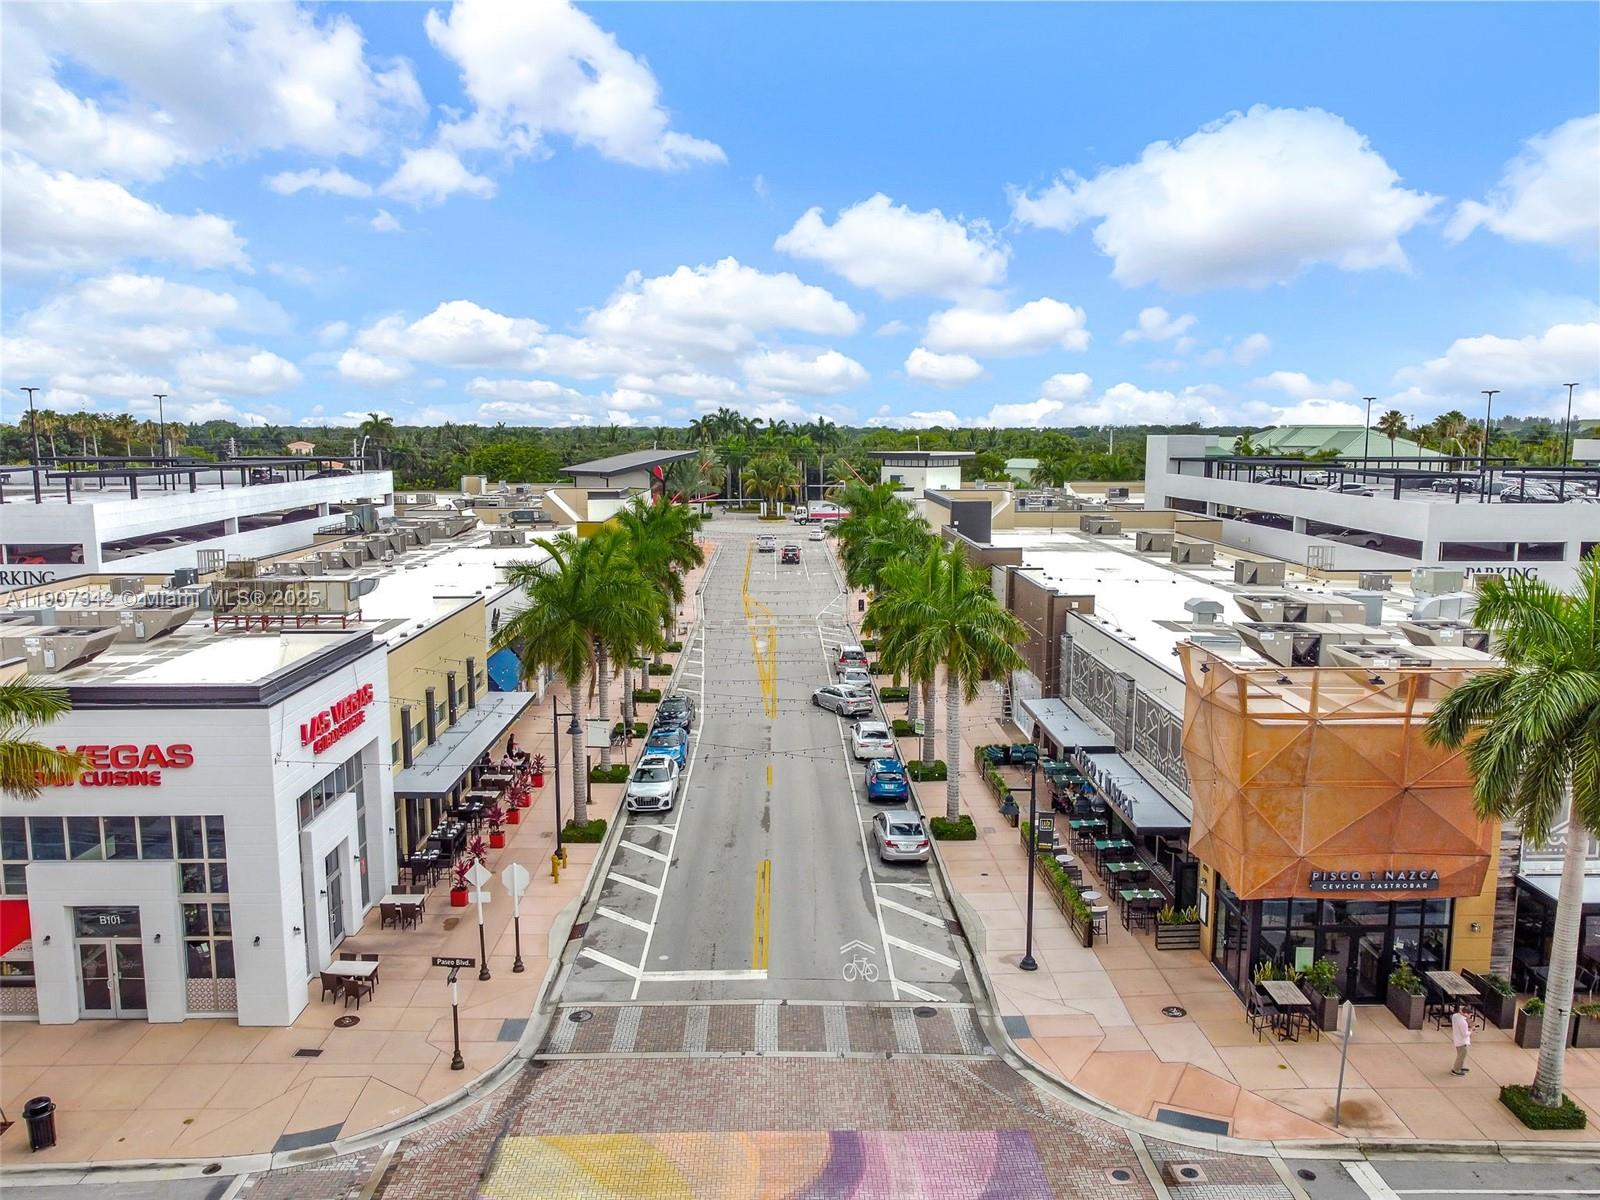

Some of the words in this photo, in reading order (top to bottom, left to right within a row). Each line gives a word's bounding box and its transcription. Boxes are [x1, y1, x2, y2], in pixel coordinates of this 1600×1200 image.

[300, 710, 331, 746] LAS
[330, 683, 373, 725] VEGAS
[80, 771, 162, 787] CUISINE
[1312, 871, 1360, 880] PISCO
[1385, 871, 1439, 880] NAZCA
[99, 915, 120, 925] B101
